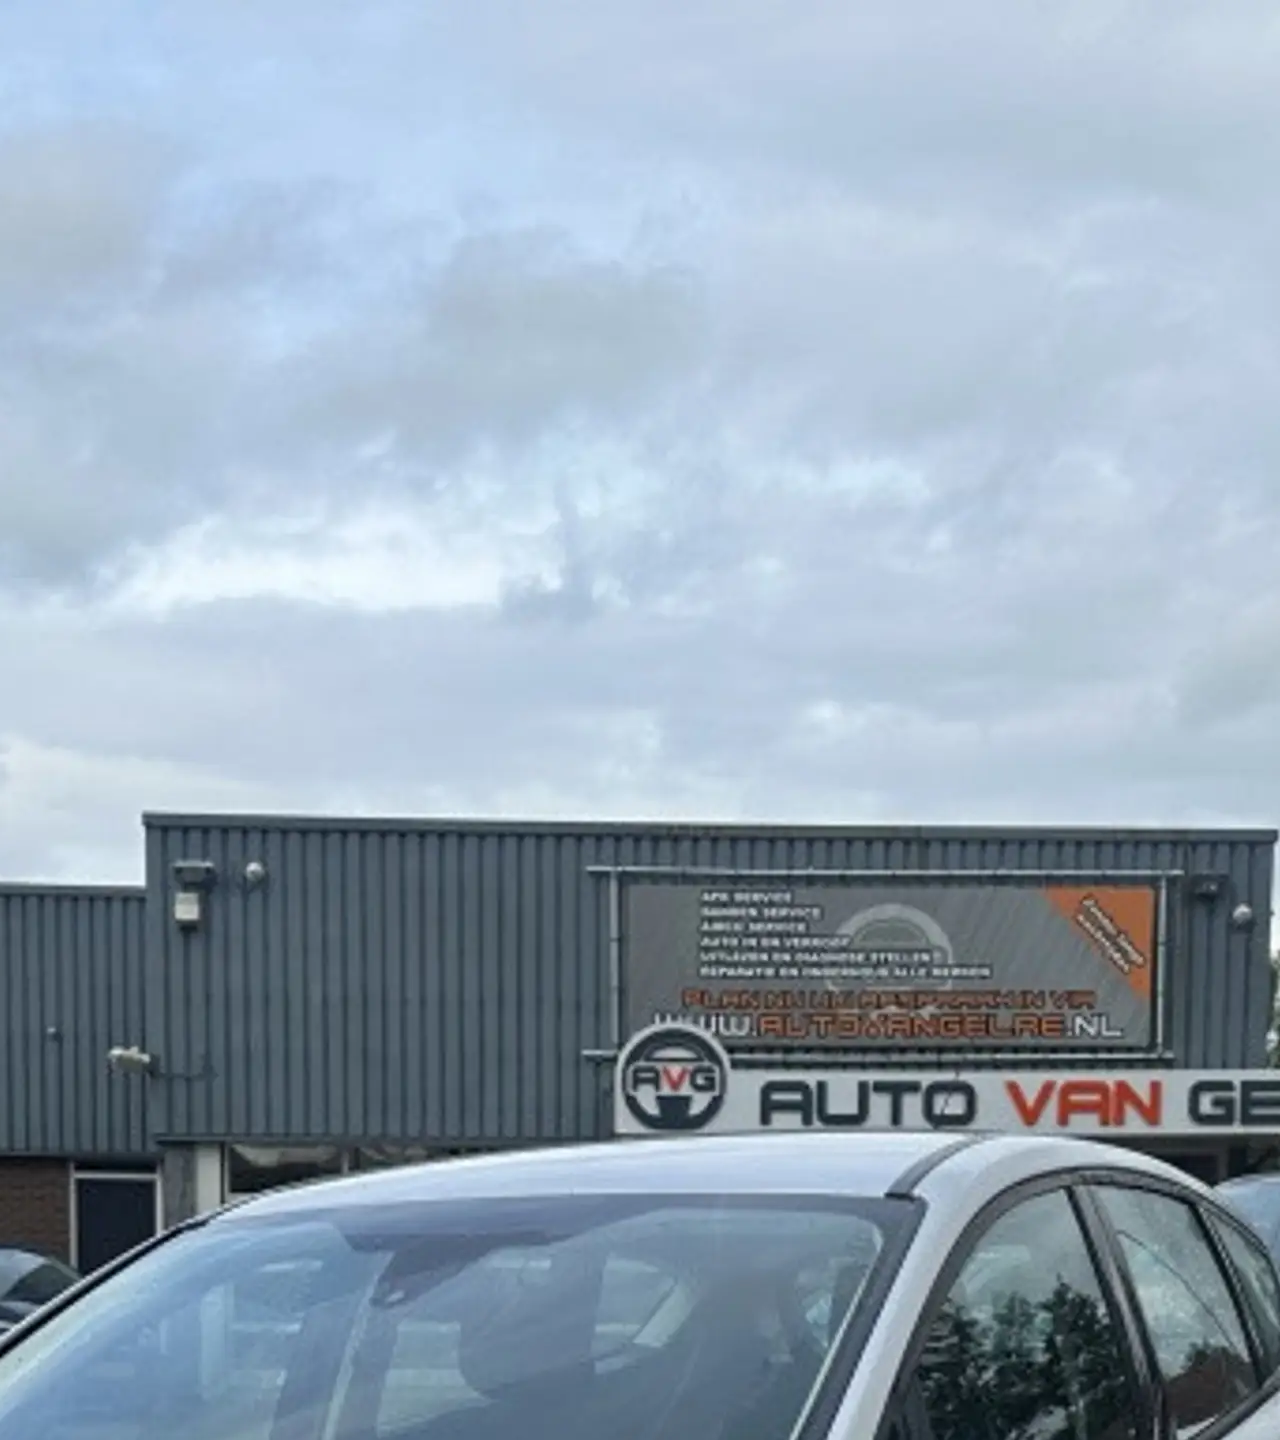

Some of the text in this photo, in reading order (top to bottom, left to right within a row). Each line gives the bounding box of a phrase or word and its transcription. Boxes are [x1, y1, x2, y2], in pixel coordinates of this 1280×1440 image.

[631, 1066, 717, 1092] AVG
[759, 1080, 977, 1128] AUTO
[1004, 1079, 1163, 1127] VAN
